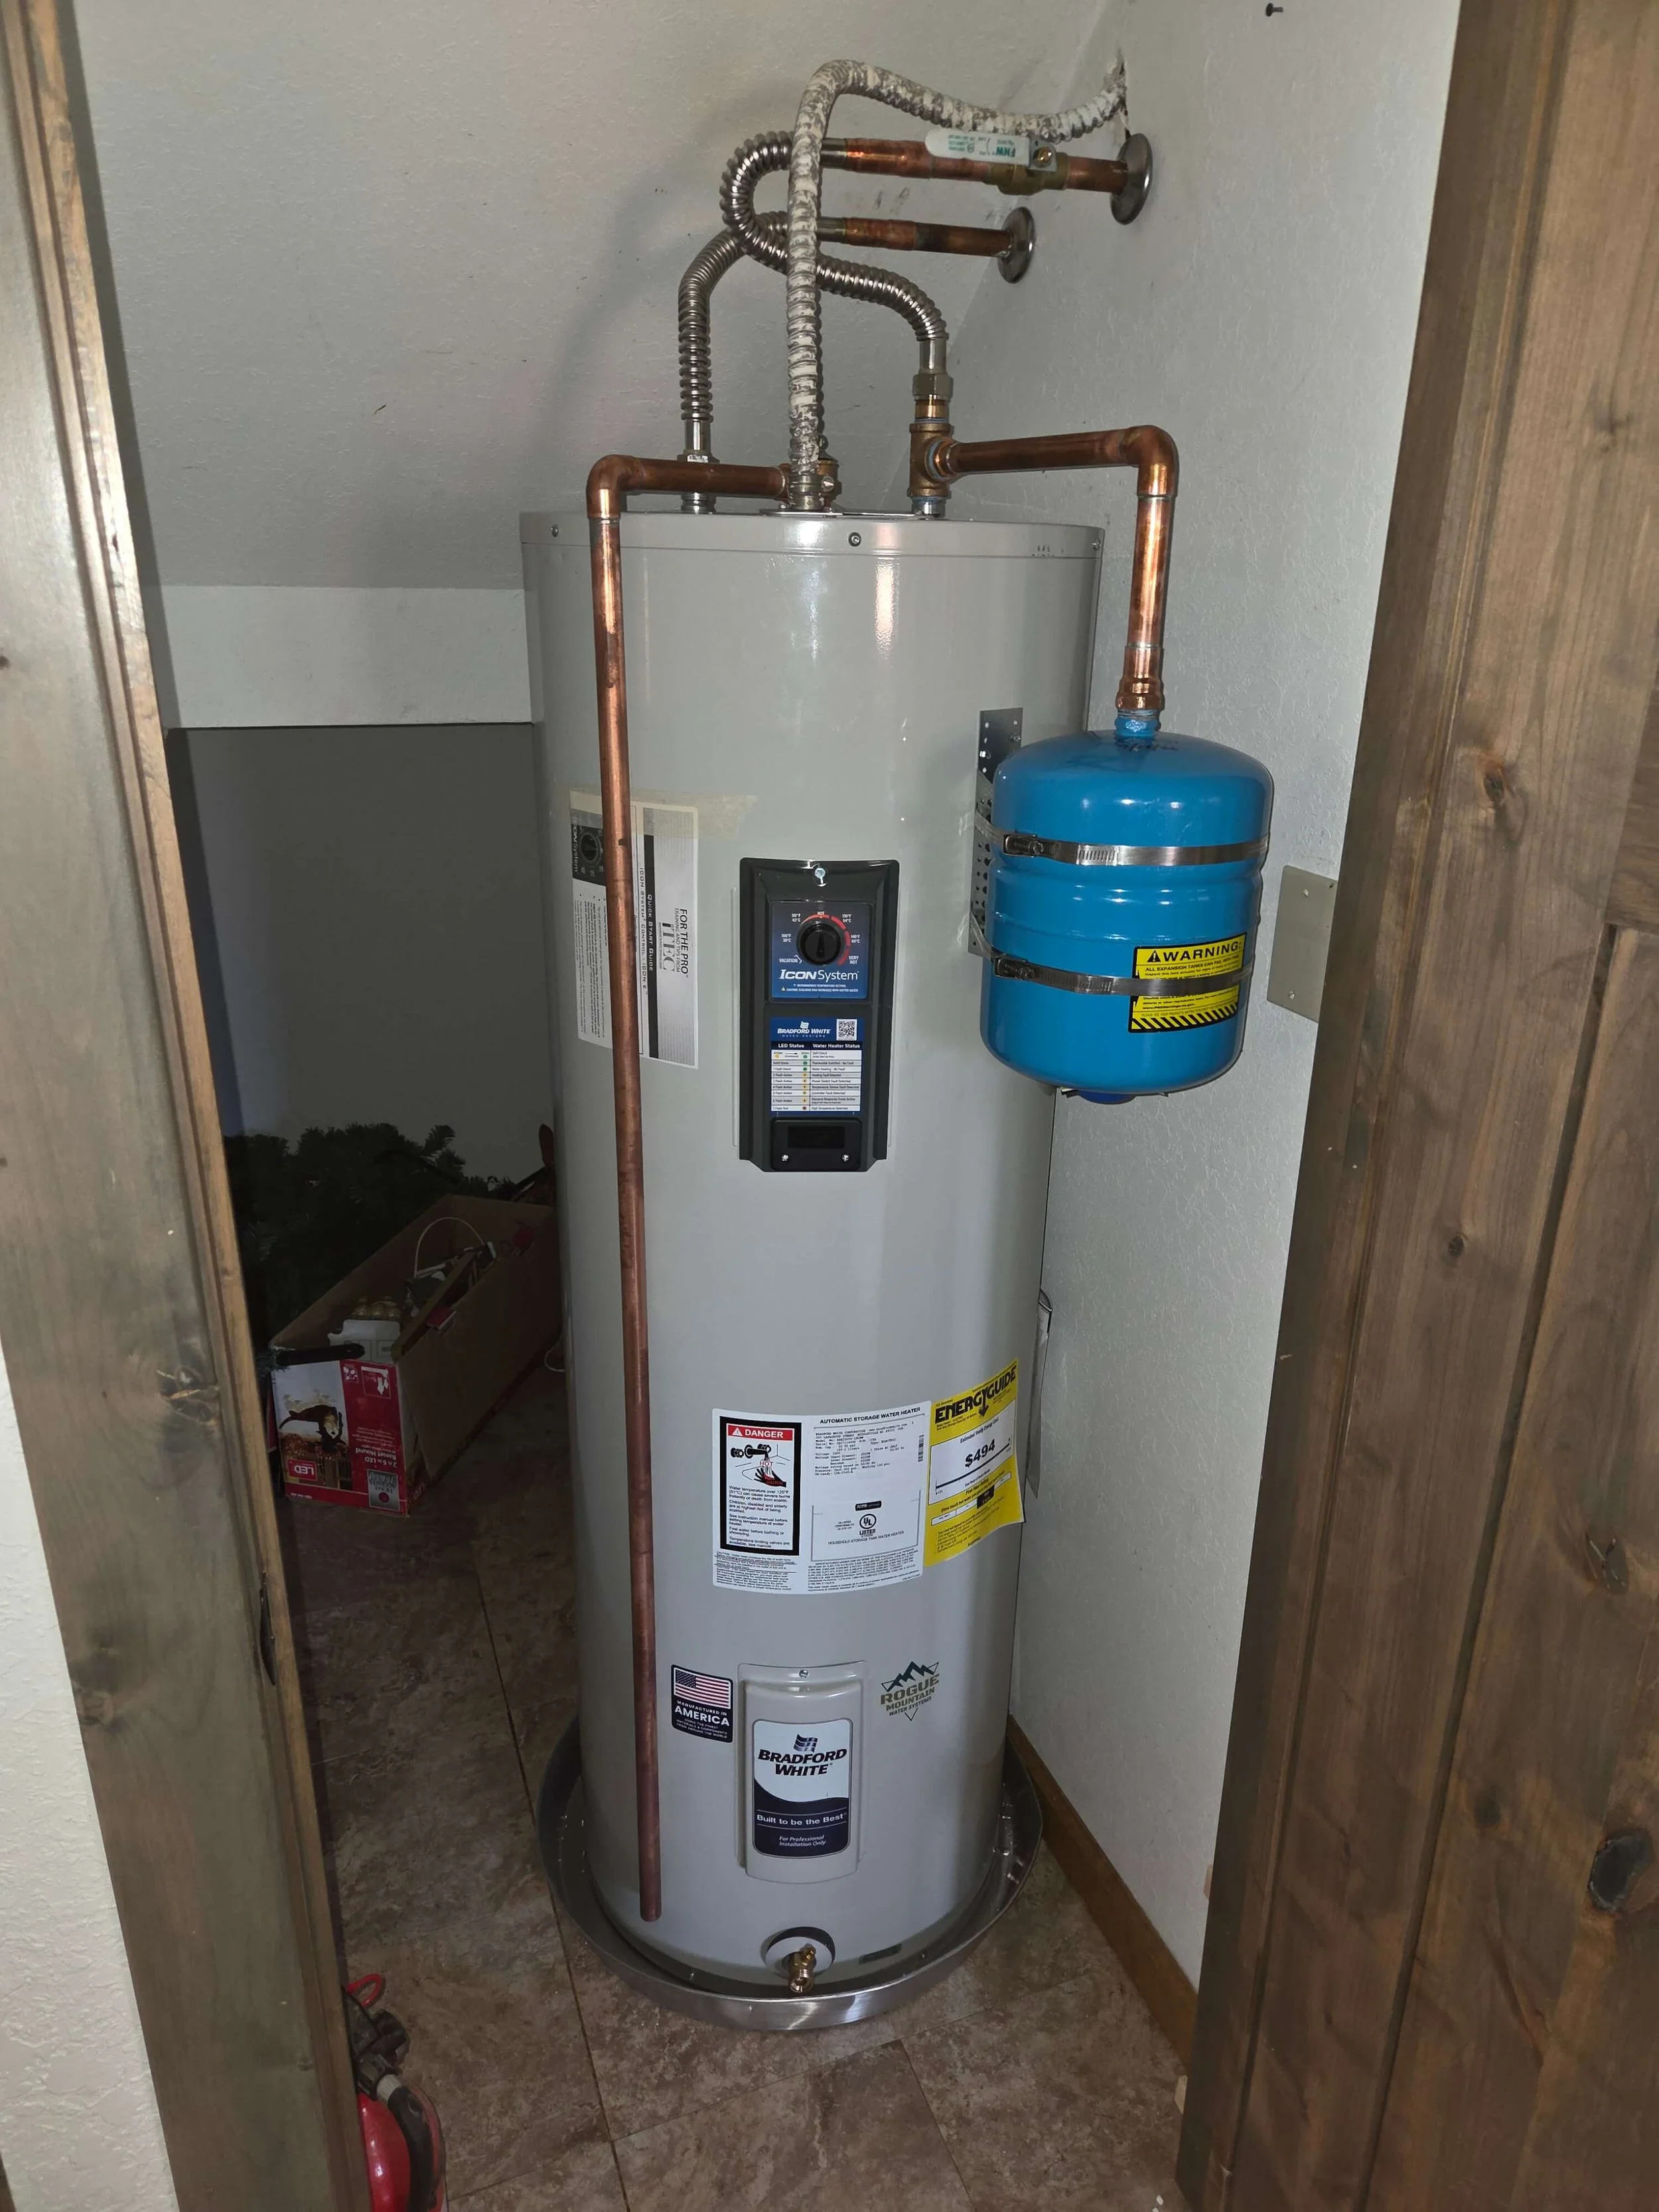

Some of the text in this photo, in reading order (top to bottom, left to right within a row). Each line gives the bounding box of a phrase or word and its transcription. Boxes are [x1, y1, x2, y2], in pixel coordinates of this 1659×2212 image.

[1163, 941, 1242, 962] WARNING:
[935, 1364, 1017, 1424] ENERGYGUIDE
[881, 1410, 900, 1419] WATER
[745, 1429, 784, 1438] DANGER
[356, 1447, 397, 1461] Basset Hound
[965, 1439, 995, 1468] $494
[294, 1465, 314, 1475] LED
[863, 1517, 872, 1526] UL
[881, 1673, 939, 1705] ROGUE
[886, 1686, 934, 1711] MOUNTAIN
[678, 1700, 719, 1714] MANUFACTURED
[889, 1696, 932, 1716] WATER SYSTEMS
[675, 1705, 729, 1726] AMERICA
[758, 1749, 847, 1764] BRADFORD
[775, 1763, 828, 1776] WHITE
[757, 1814, 776, 1824] Built
[823, 1813, 843, 1823] Best
